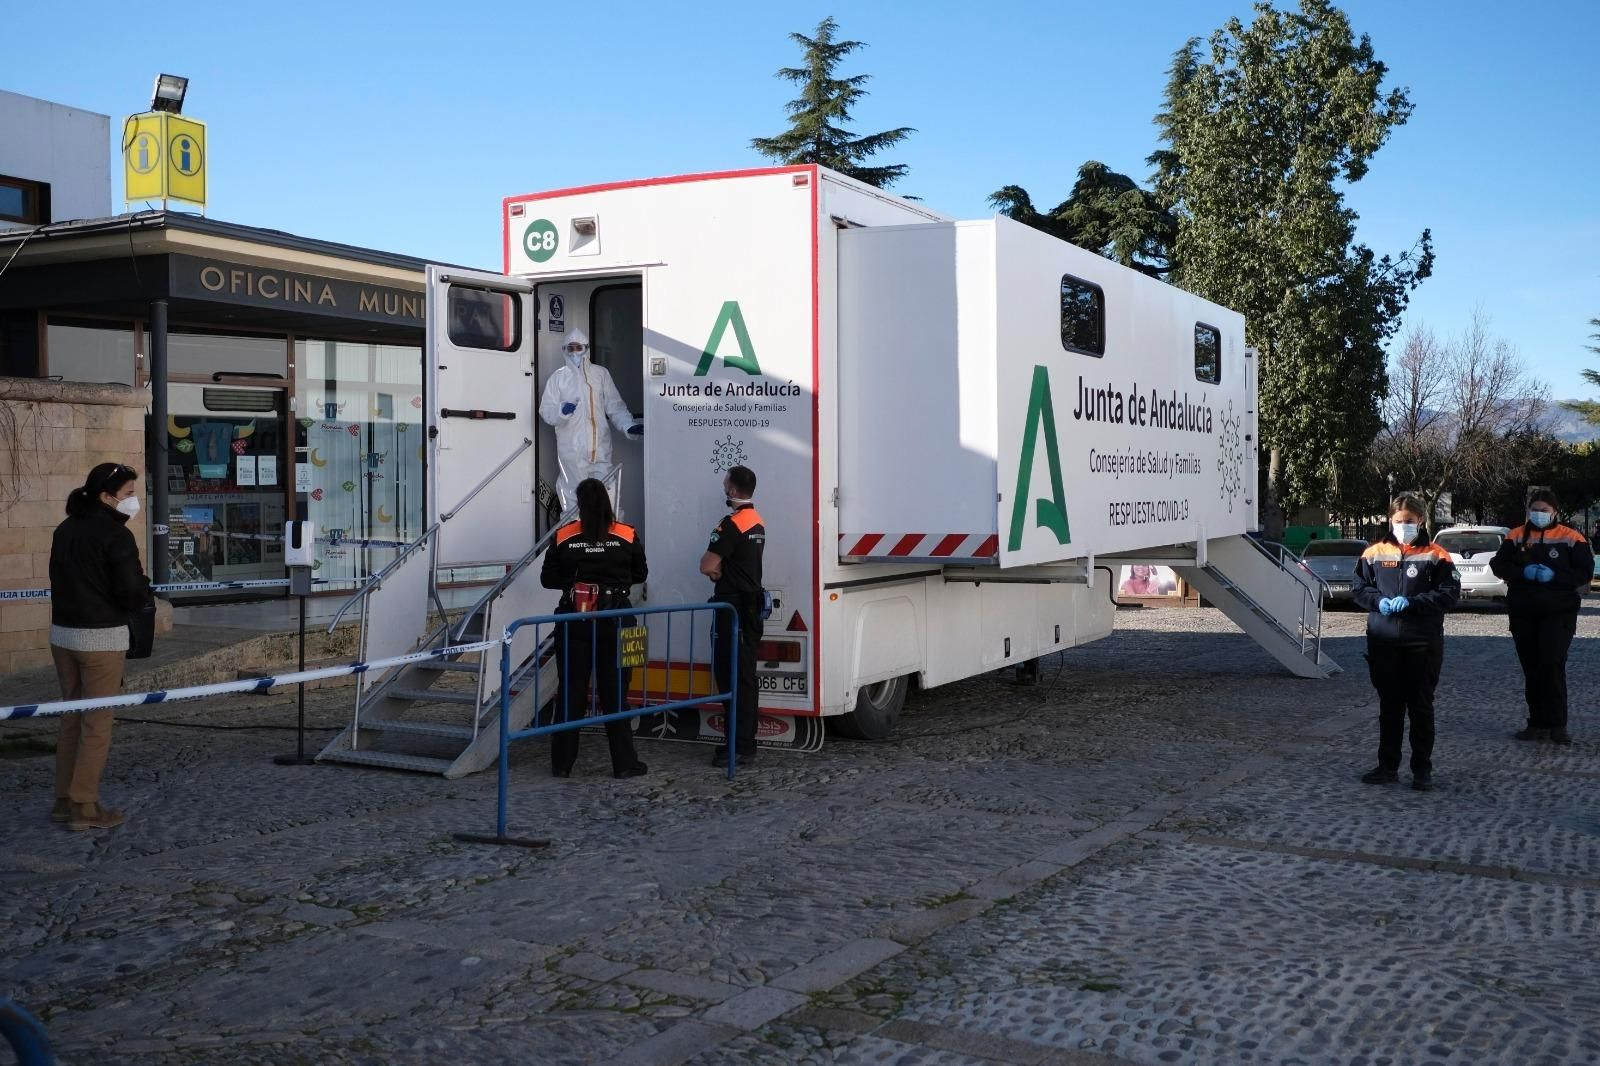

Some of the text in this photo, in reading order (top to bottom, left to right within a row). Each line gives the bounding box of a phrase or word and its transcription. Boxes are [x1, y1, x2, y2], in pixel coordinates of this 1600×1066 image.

[527, 231, 555, 251] C8
[200, 266, 425, 319] OFICINA MUNI
[659, 380, 801, 397] Junta de Andalucía
[714, 403, 723, 412] de
[725, 403, 747, 412] Salud
[748, 405, 753, 414] y
[755, 403, 787, 412] Familias
[1073, 375, 1212, 434] Junta de Andalucía
[688, 419, 770, 427] RESPUESTA COVID-19
[1089, 446, 1201, 480] Consejería de Salud y Familias
[1109, 499, 1189, 526] RESPUESTA COVID-19
[622, 640, 645, 654] LOCAL
[783, 677, 805, 690] CFG
